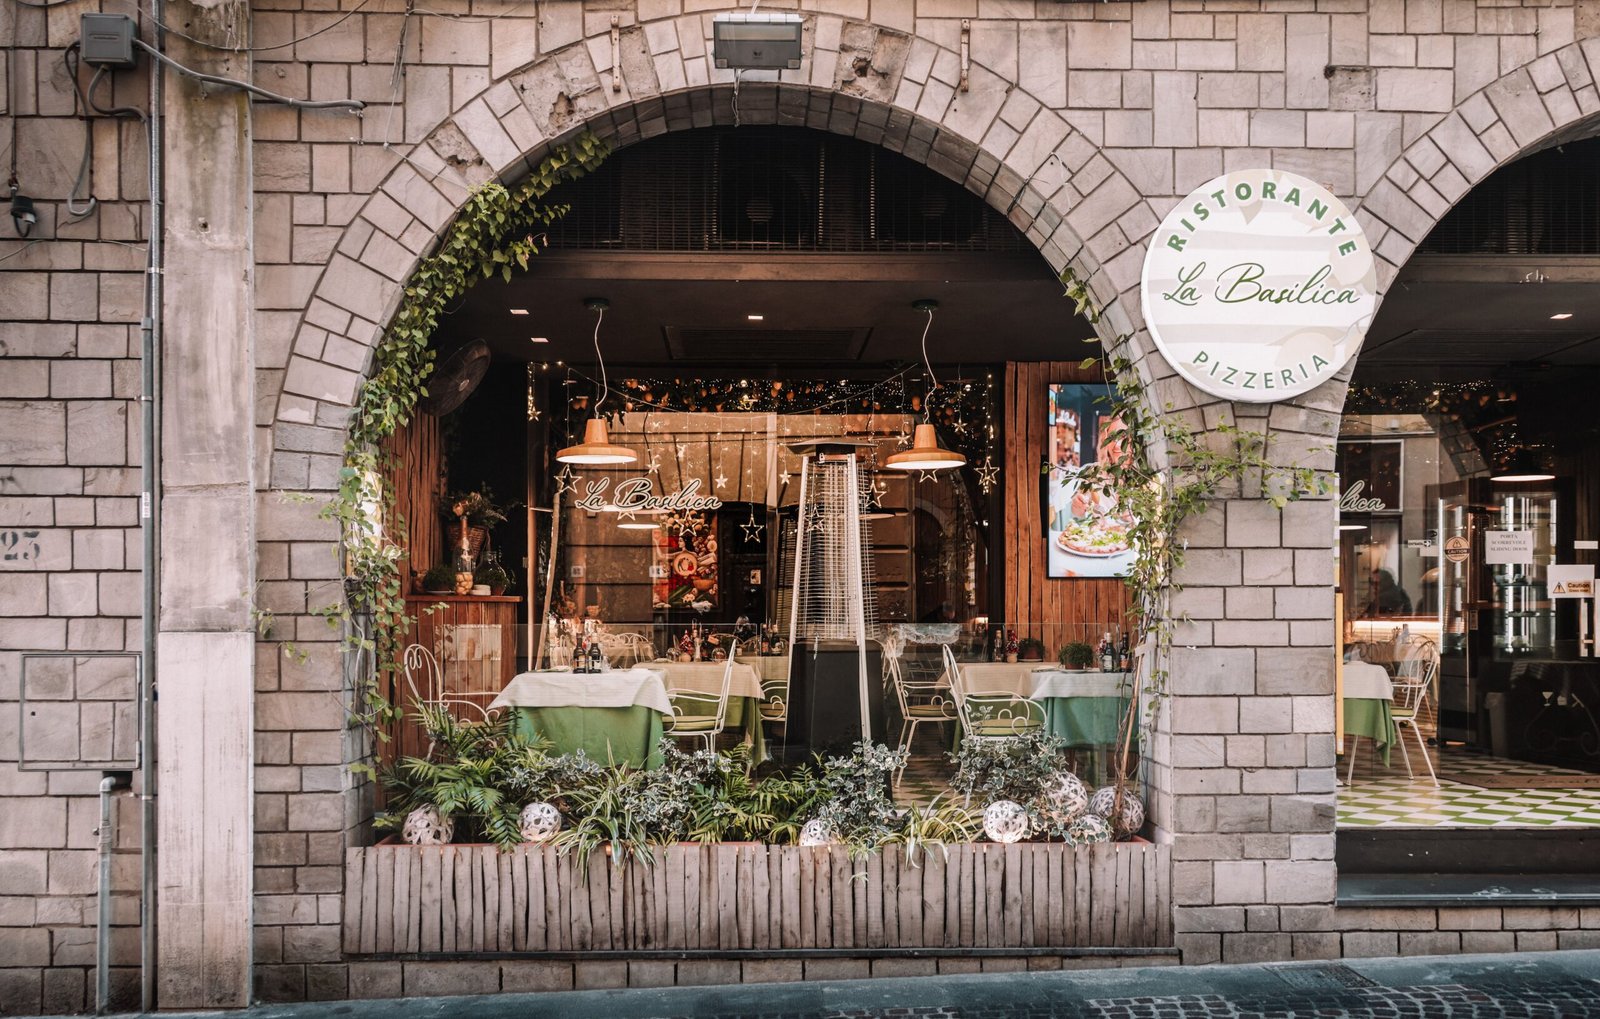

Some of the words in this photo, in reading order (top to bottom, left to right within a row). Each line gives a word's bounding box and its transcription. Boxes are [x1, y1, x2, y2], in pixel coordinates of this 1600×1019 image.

[1166, 181, 1358, 257] RISTORANTE
[1163, 261, 1207, 306] La
[1214, 262, 1362, 306] Basilica
[1192, 350, 1329, 389] PIZZERIA
[575, 476, 610, 511] La
[613, 476, 723, 512] Basilica
[1339, 479, 1386, 512] lica
